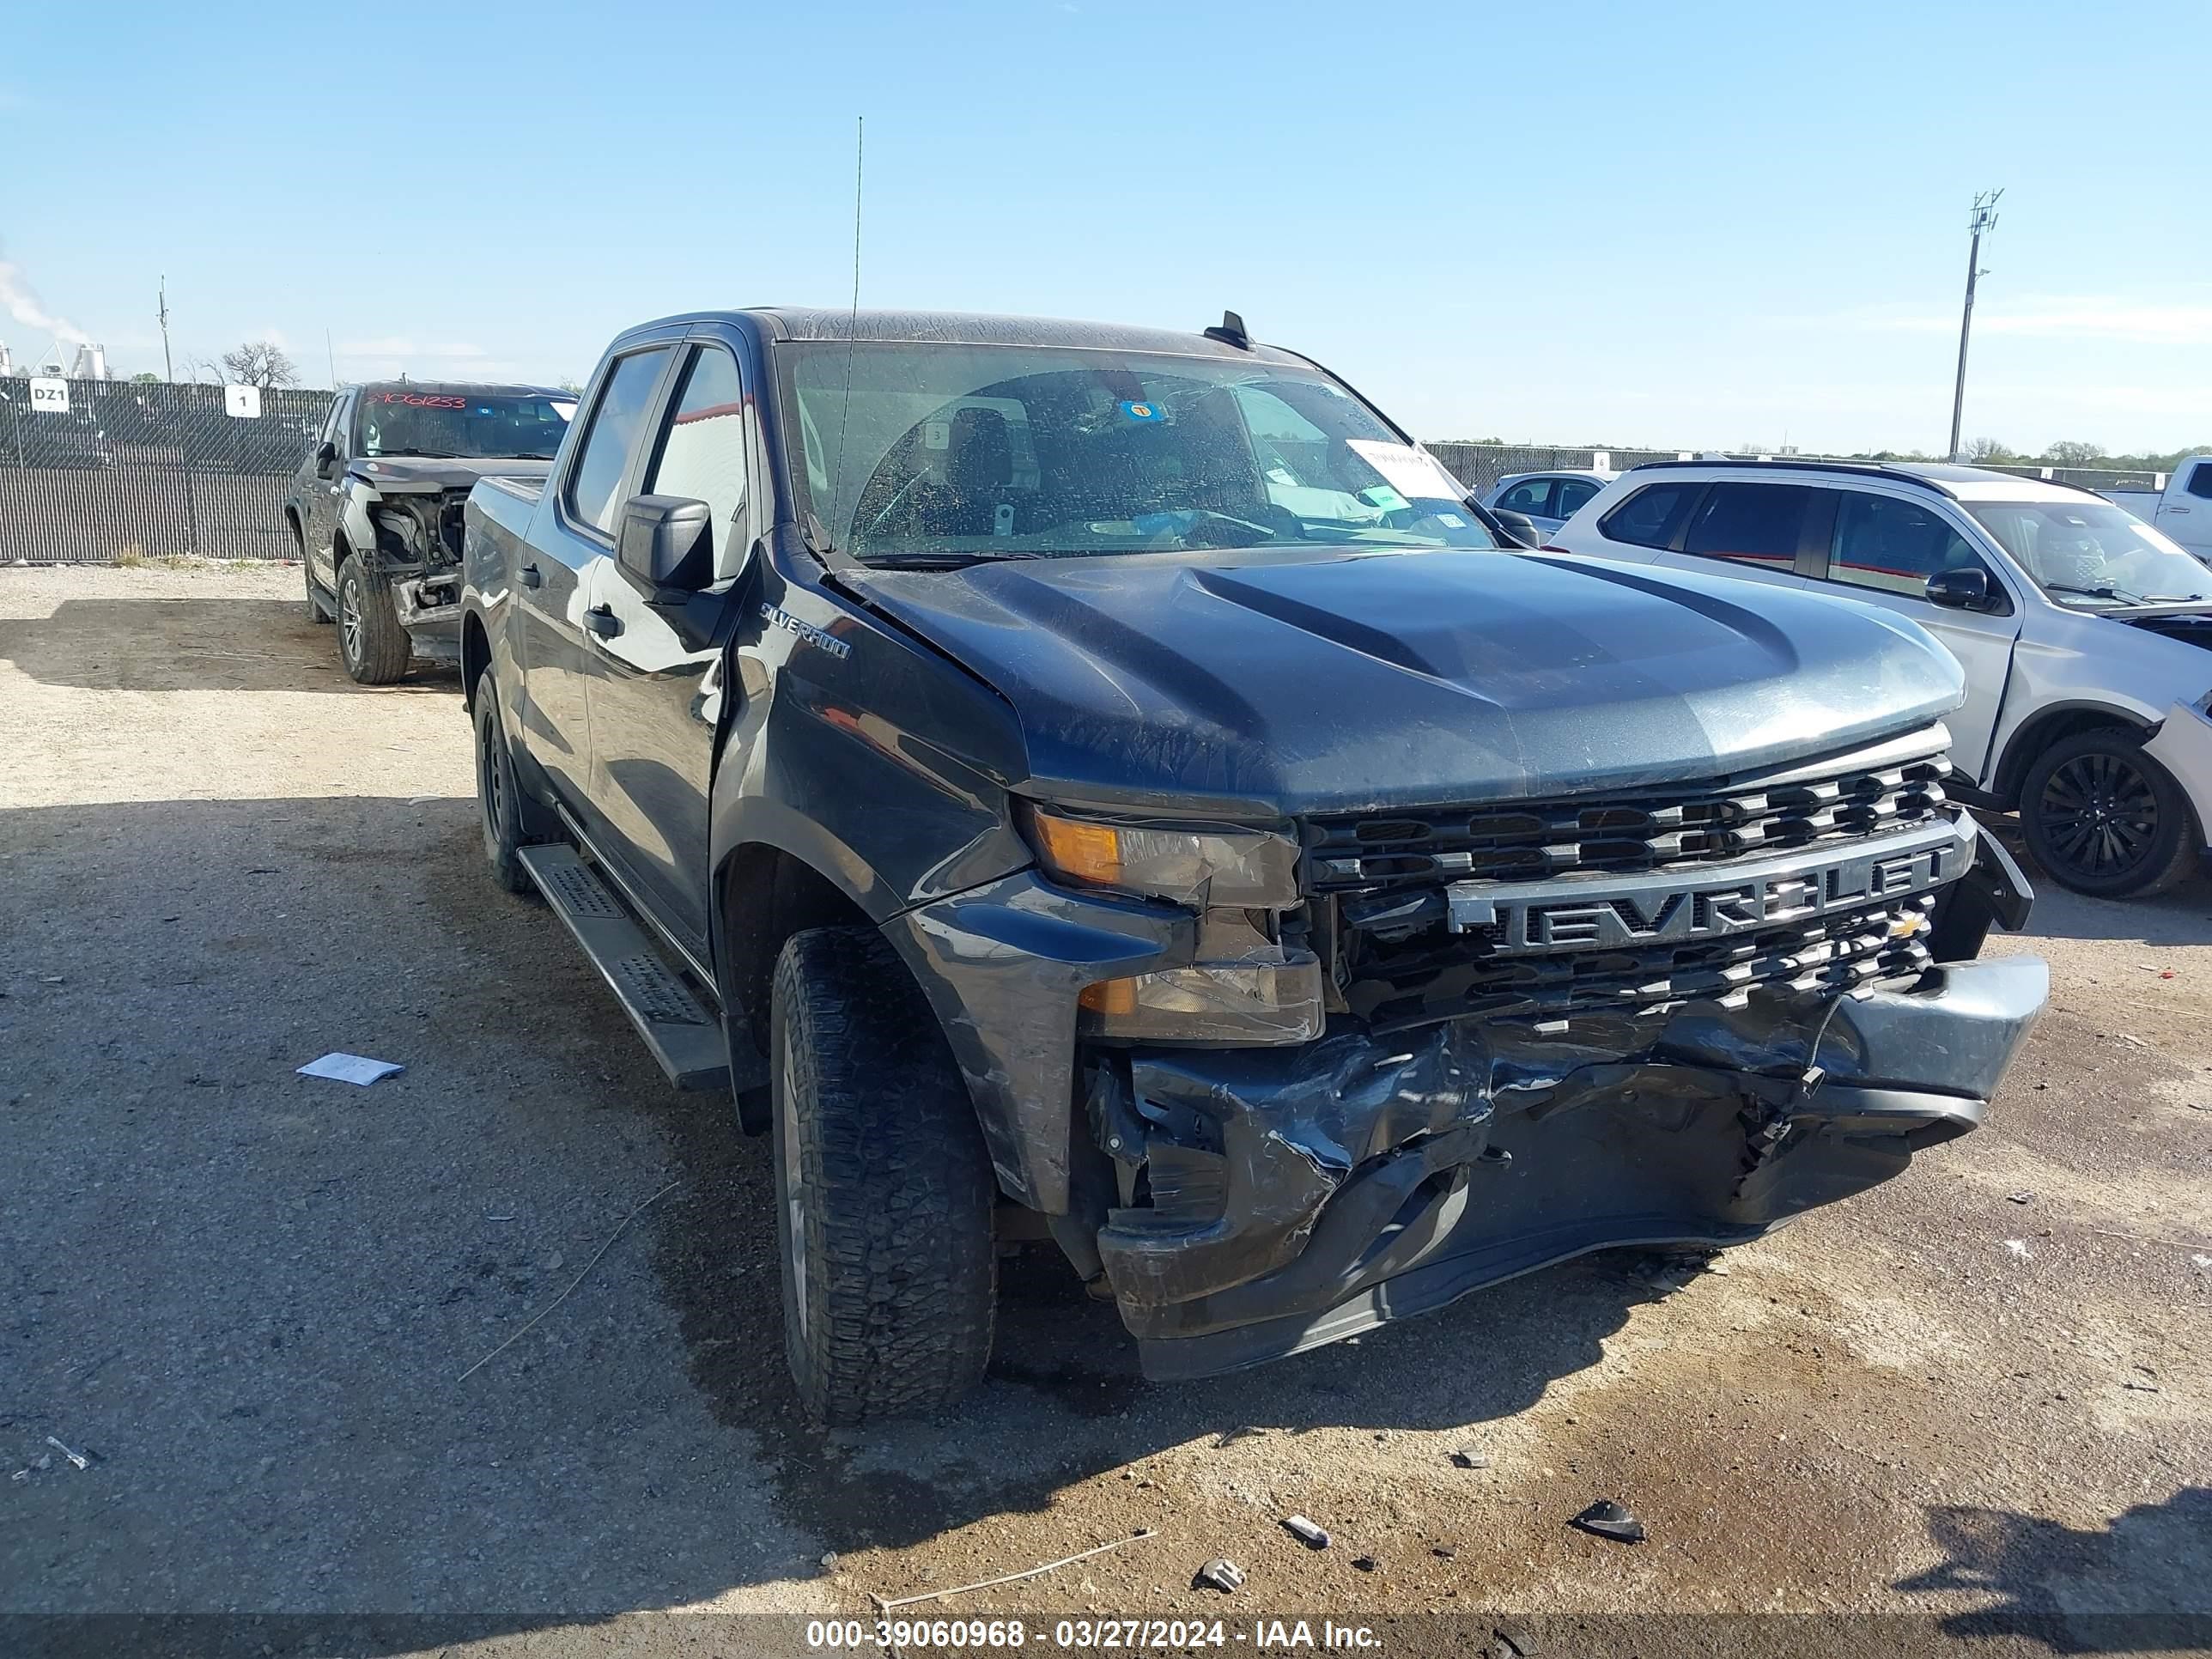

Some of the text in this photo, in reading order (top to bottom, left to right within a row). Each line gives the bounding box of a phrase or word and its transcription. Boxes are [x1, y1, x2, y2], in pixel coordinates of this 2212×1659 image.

[34, 389, 64, 400] DZ1
[239, 396, 246, 407] 1
[933, 431, 940, 441] 3
[759, 602, 851, 659] SILVERADO
